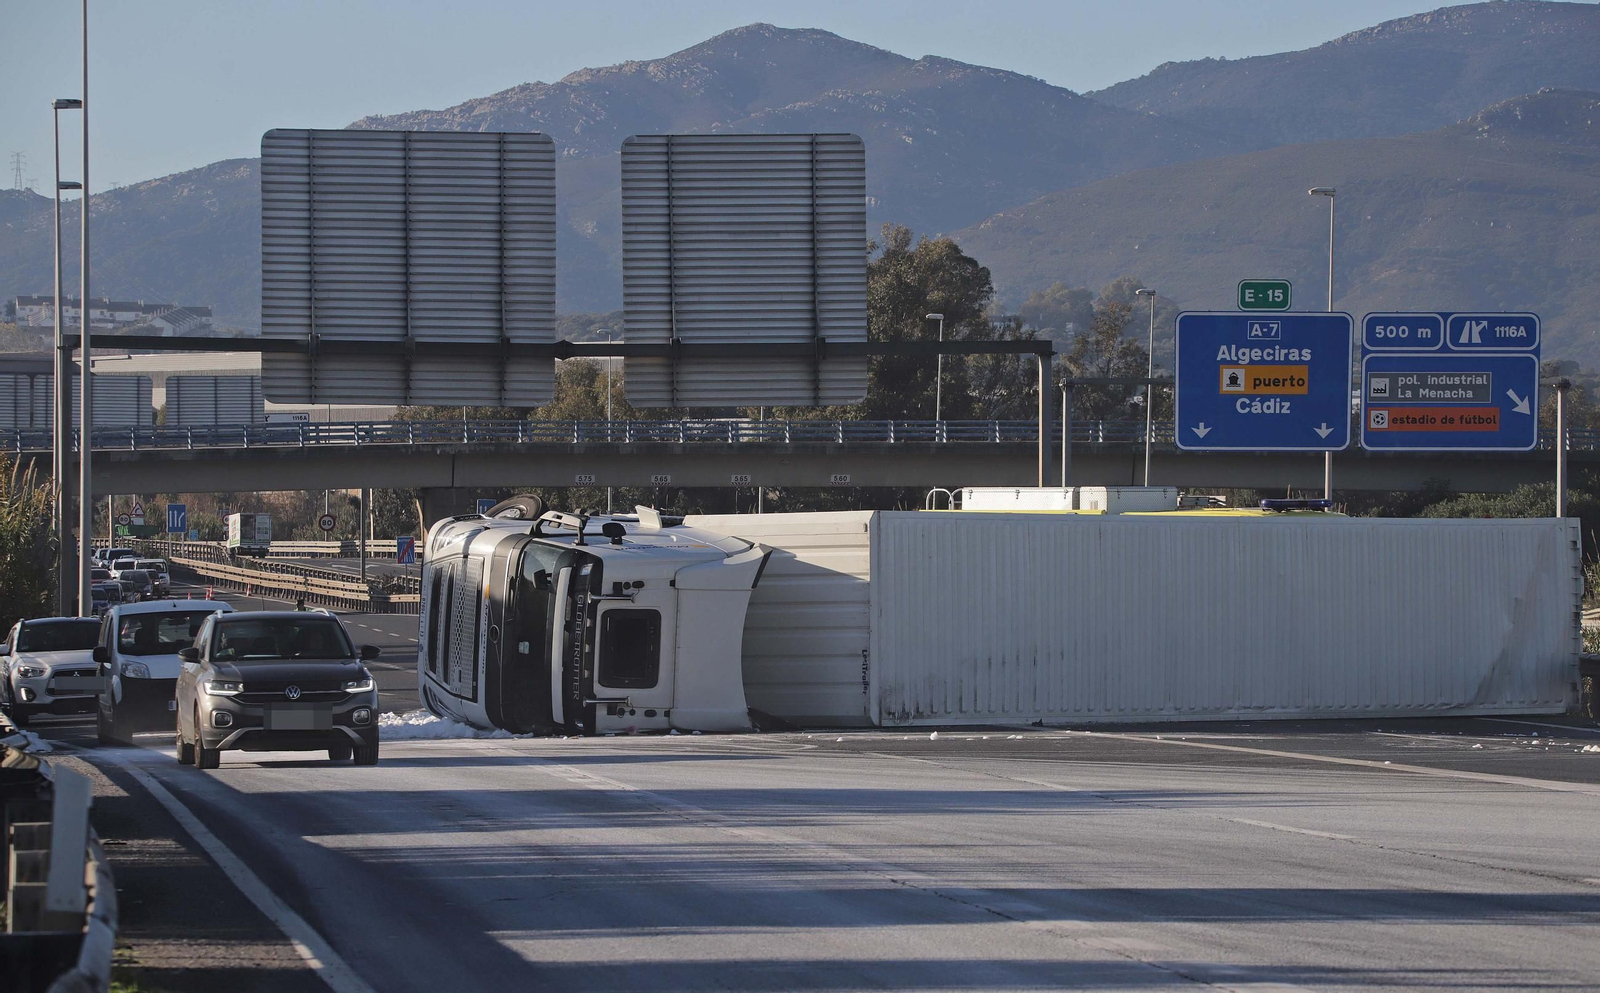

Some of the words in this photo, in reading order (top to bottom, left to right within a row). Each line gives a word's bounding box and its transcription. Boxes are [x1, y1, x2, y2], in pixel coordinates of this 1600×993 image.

[1245, 289, 1255, 302] E
[1267, 289, 1284, 302] 15
[1250, 323, 1278, 337] A-7
[1375, 325, 1409, 338] 500
[1417, 327, 1432, 338] m
[1494, 325, 1527, 338] 1116A
[1216, 344, 1312, 365] Algeciras
[1253, 375, 1306, 390] puerto
[1398, 374, 1421, 387] pol.
[1427, 374, 1488, 385] industrial
[1398, 388, 1412, 398] La
[1419, 388, 1474, 398] Menacha
[1235, 397, 1291, 414] Cádiz
[1391, 414, 1437, 425] estadio
[1440, 414, 1455, 425] de
[1459, 413, 1497, 425] fútbol
[573, 594, 585, 701] GLOBETROTTER
